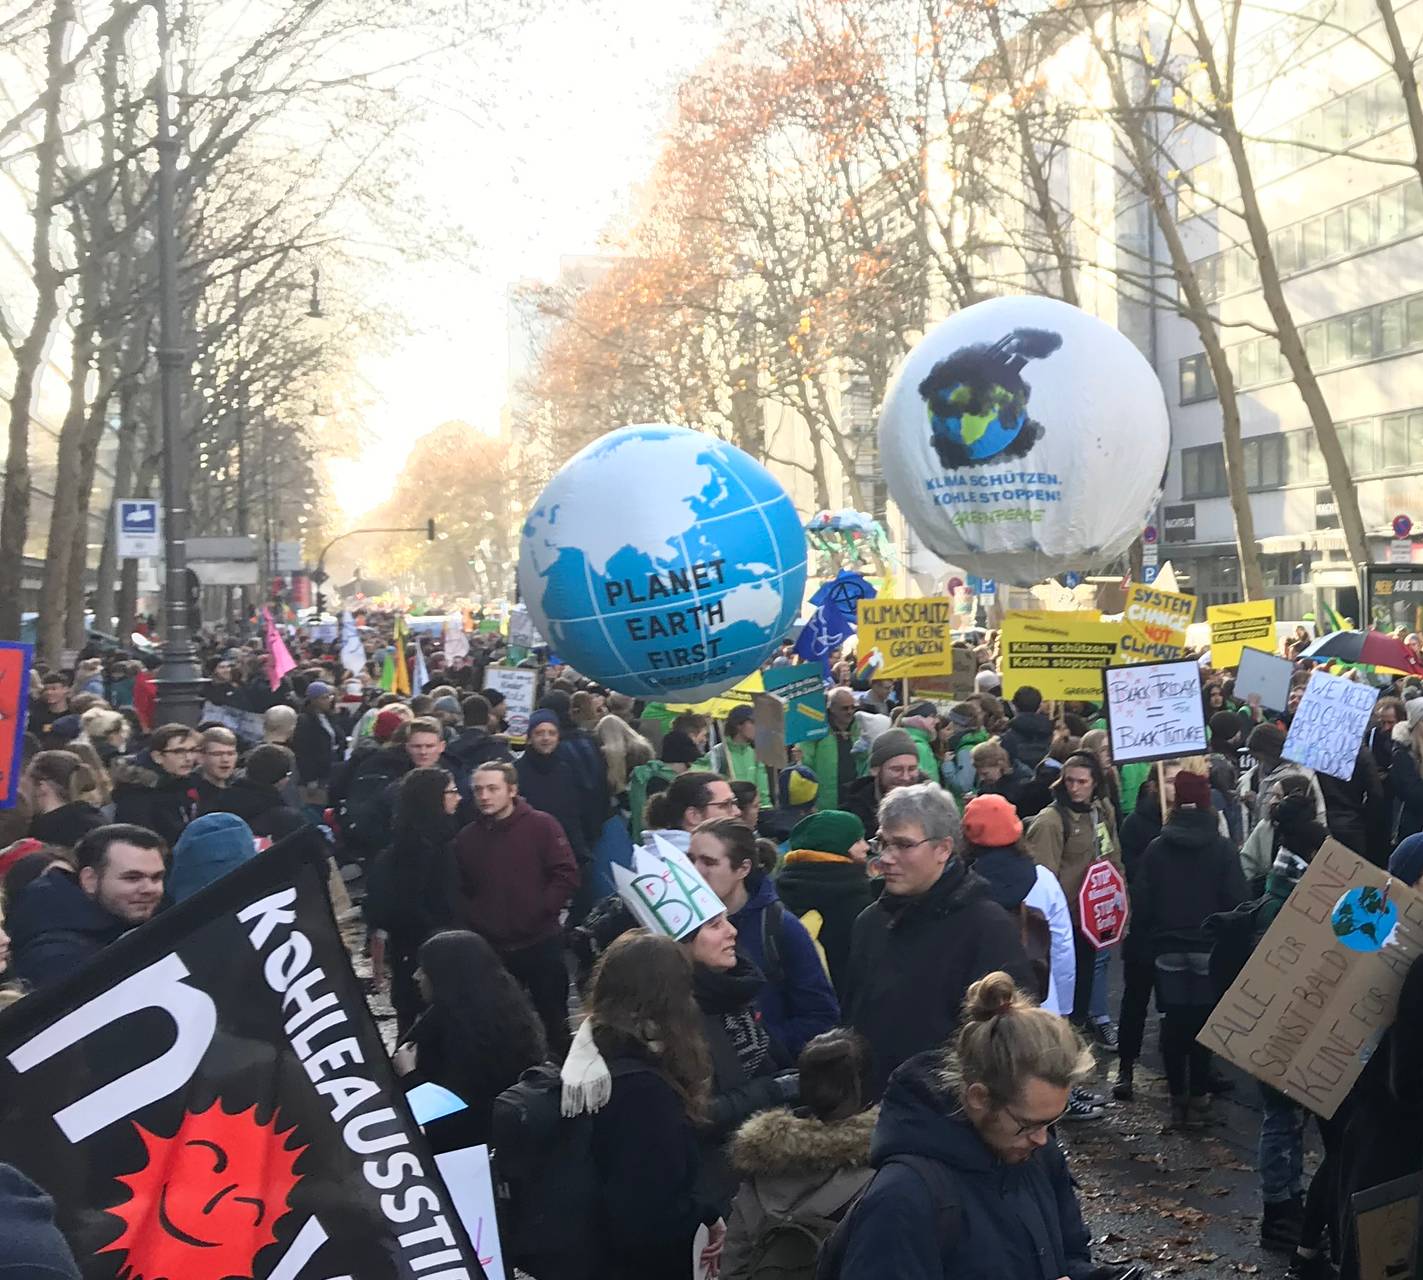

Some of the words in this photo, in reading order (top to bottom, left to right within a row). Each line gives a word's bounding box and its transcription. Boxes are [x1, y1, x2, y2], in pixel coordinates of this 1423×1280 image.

[926, 476, 968, 490] KLIMA
[933, 489, 977, 505] KOHLE
[979, 488, 1061, 504] STOPPEN!
[952, 509, 1046, 527] GREENPEACE
[604, 559, 726, 606] PLANET
[863, 602, 950, 625] KLIMASCHUTZ
[1135, 588, 1192, 615] SYSTEM
[625, 600, 724, 642] EARTH
[1127, 604, 1192, 632] CHANGE
[875, 625, 912, 641] KENNT
[1145, 625, 1174, 643] NOT
[648, 637, 722, 670] FIRST
[890, 640, 945, 657] GRENZEN
[1011, 643, 1048, 653] Klima
[1051, 643, 1114, 655] schützen,
[1120, 634, 1182, 660] CLIMATE
[1011, 657, 1049, 668] Kohle
[1051, 656, 1105, 669] stoppen!
[1310, 679, 1341, 700] WE
[1339, 684, 1378, 711] NEED
[1210, 978, 1276, 1058] ALLE
[1248, 1001, 1315, 1077] SONST
[1291, 948, 1348, 1009] BALD
[1287, 1019, 1365, 1104] KEINE
